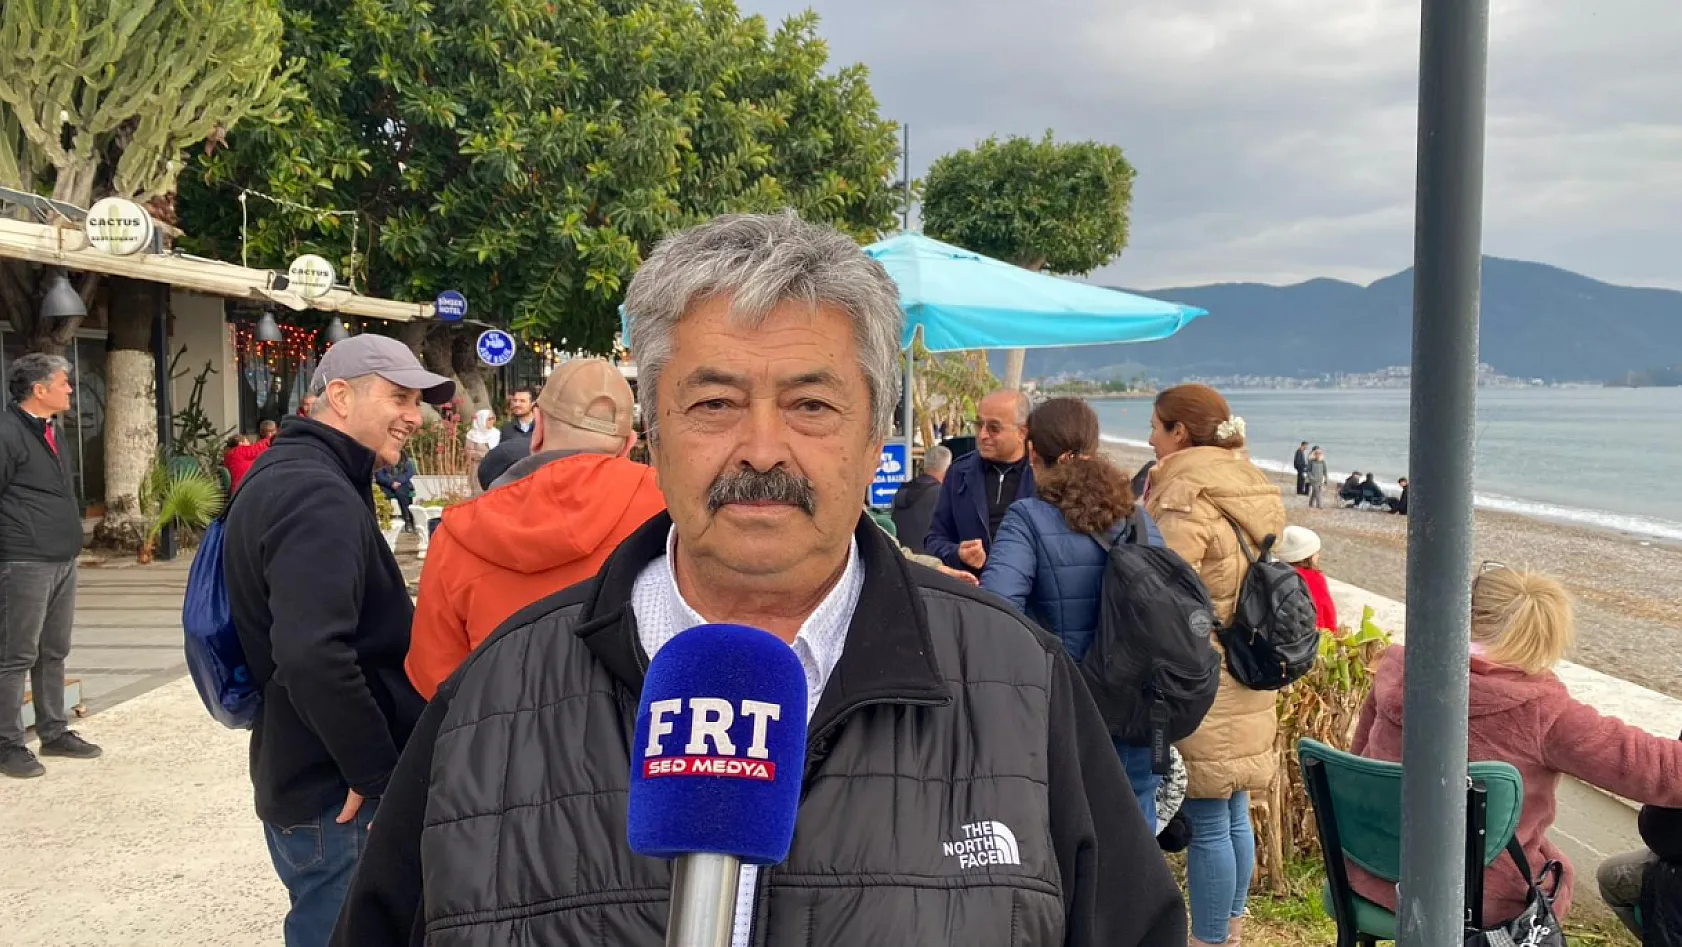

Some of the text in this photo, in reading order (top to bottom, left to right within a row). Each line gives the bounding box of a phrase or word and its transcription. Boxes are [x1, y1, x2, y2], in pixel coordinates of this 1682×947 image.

[89, 217, 141, 227] CACTUS
[291, 267, 329, 277] CACTUS
[644, 697, 781, 759] FRT
[648, 758, 769, 778] SED MEDYA
[961, 820, 993, 839] THE
[942, 836, 995, 857] NORTH
[959, 850, 998, 869] FACE
